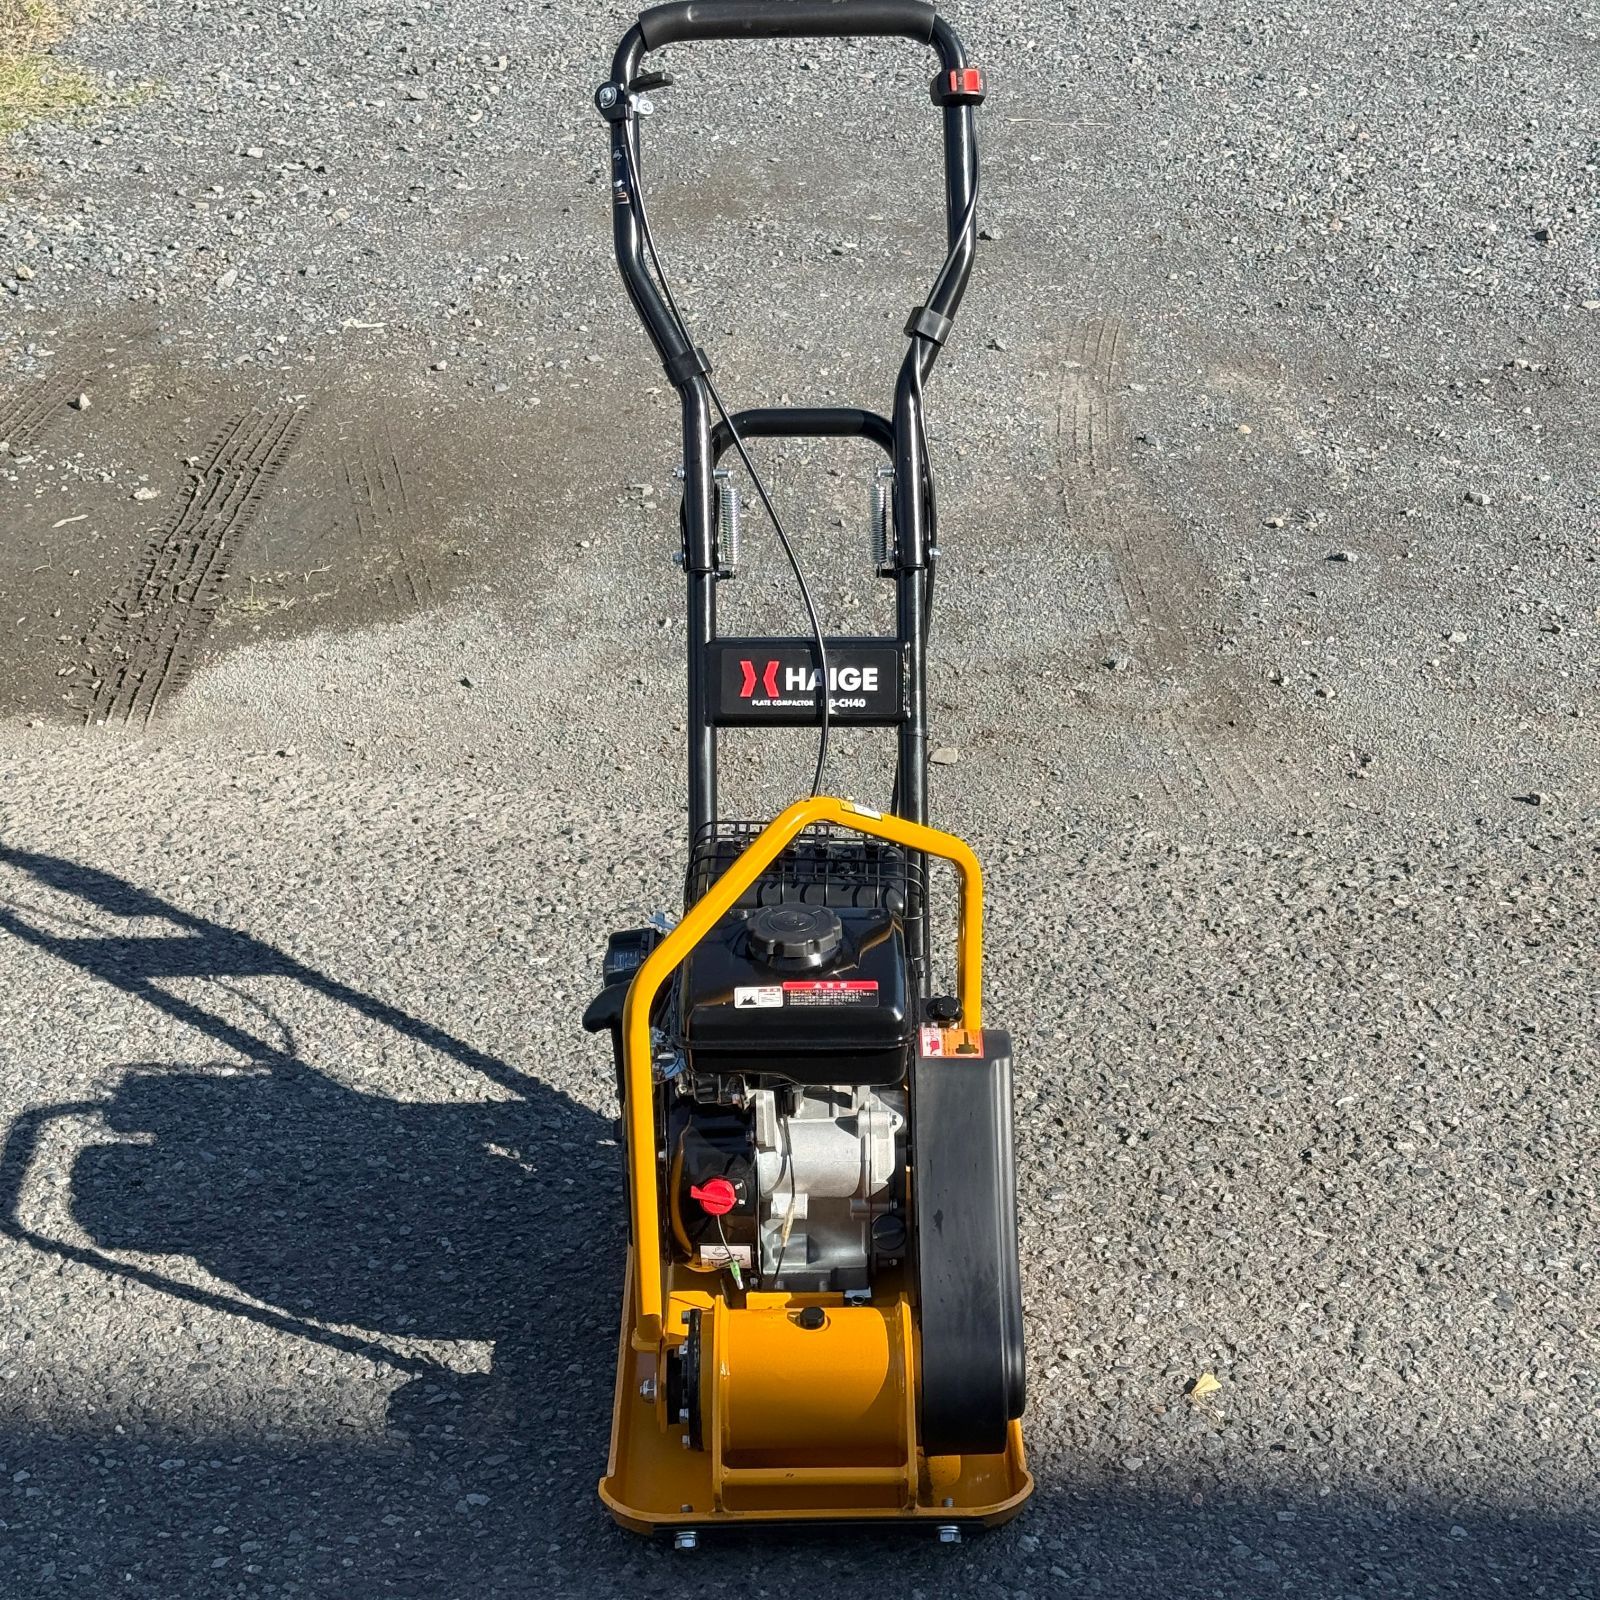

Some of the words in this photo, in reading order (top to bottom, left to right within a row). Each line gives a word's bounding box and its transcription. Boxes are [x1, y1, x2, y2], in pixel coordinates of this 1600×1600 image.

[785, 667, 879, 691] HAIGE
[751, 699, 771, 707] PLATE
[772, 699, 814, 707] COMPACTOR
